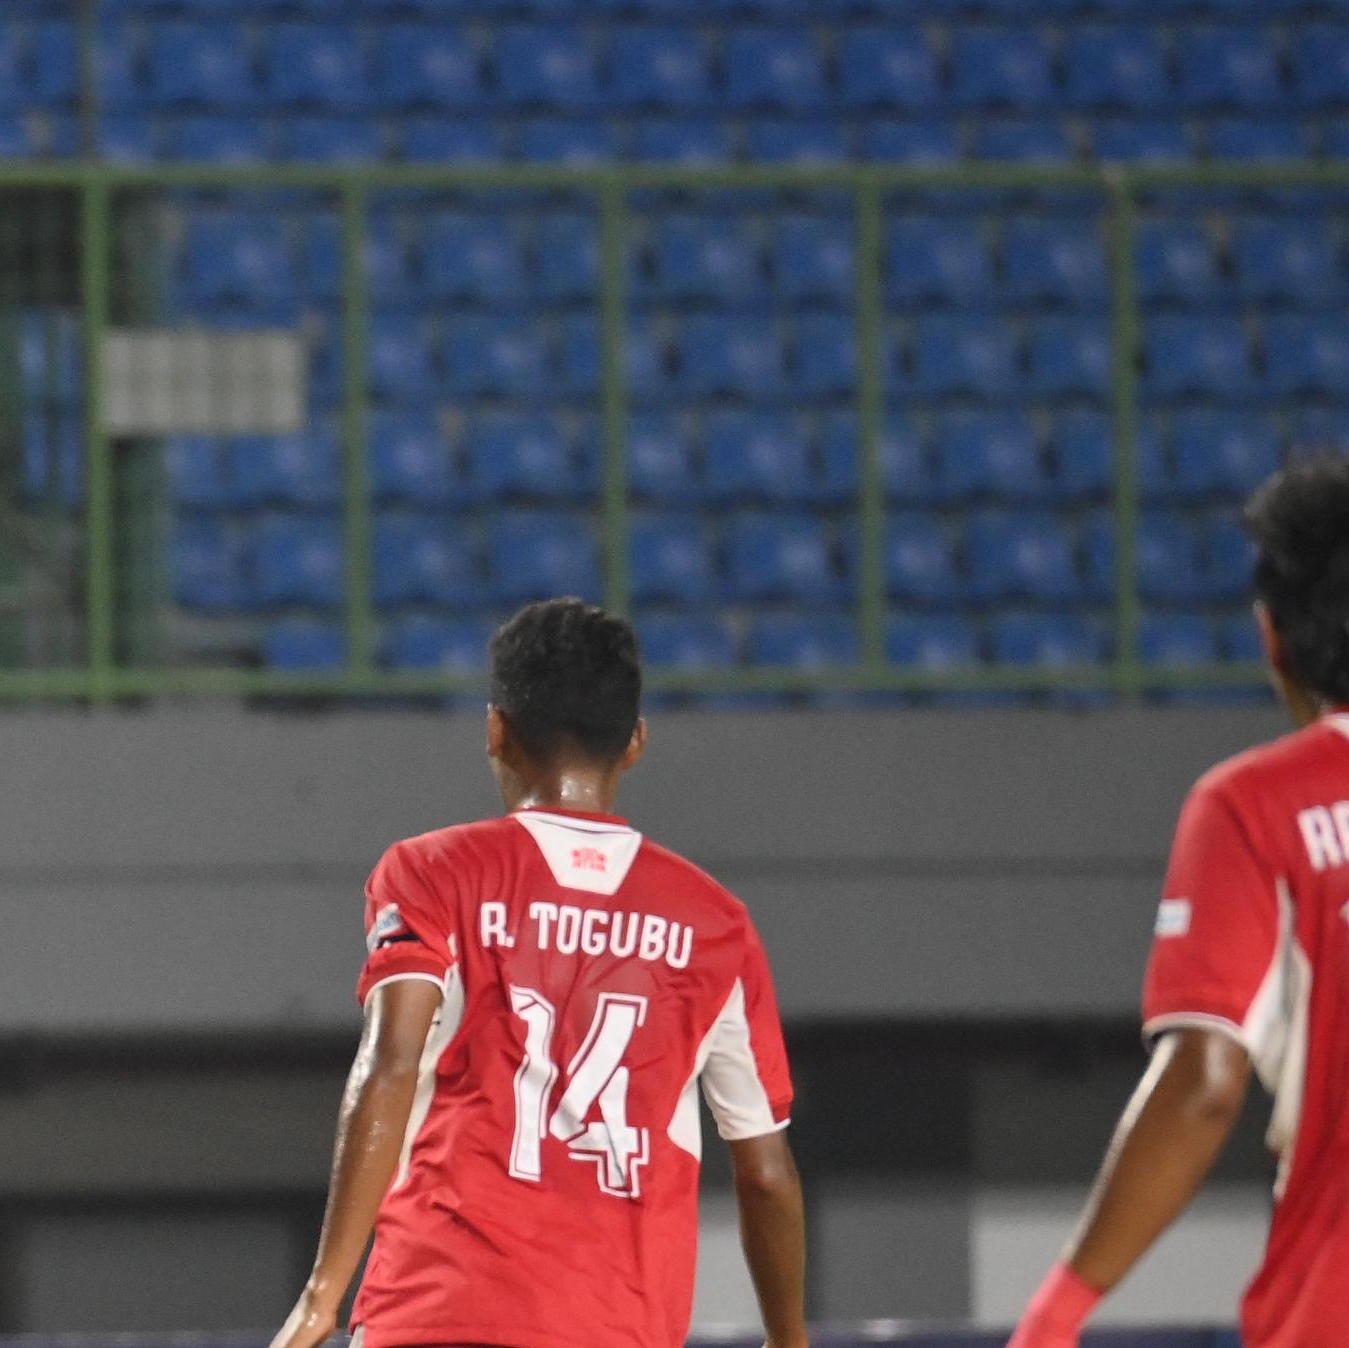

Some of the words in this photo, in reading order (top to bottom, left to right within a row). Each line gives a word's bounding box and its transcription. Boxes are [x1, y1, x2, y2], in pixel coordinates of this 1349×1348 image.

[480, 901, 516, 948] R.
[529, 901, 694, 969] TOGUBU
[508, 983, 649, 1198] 14
